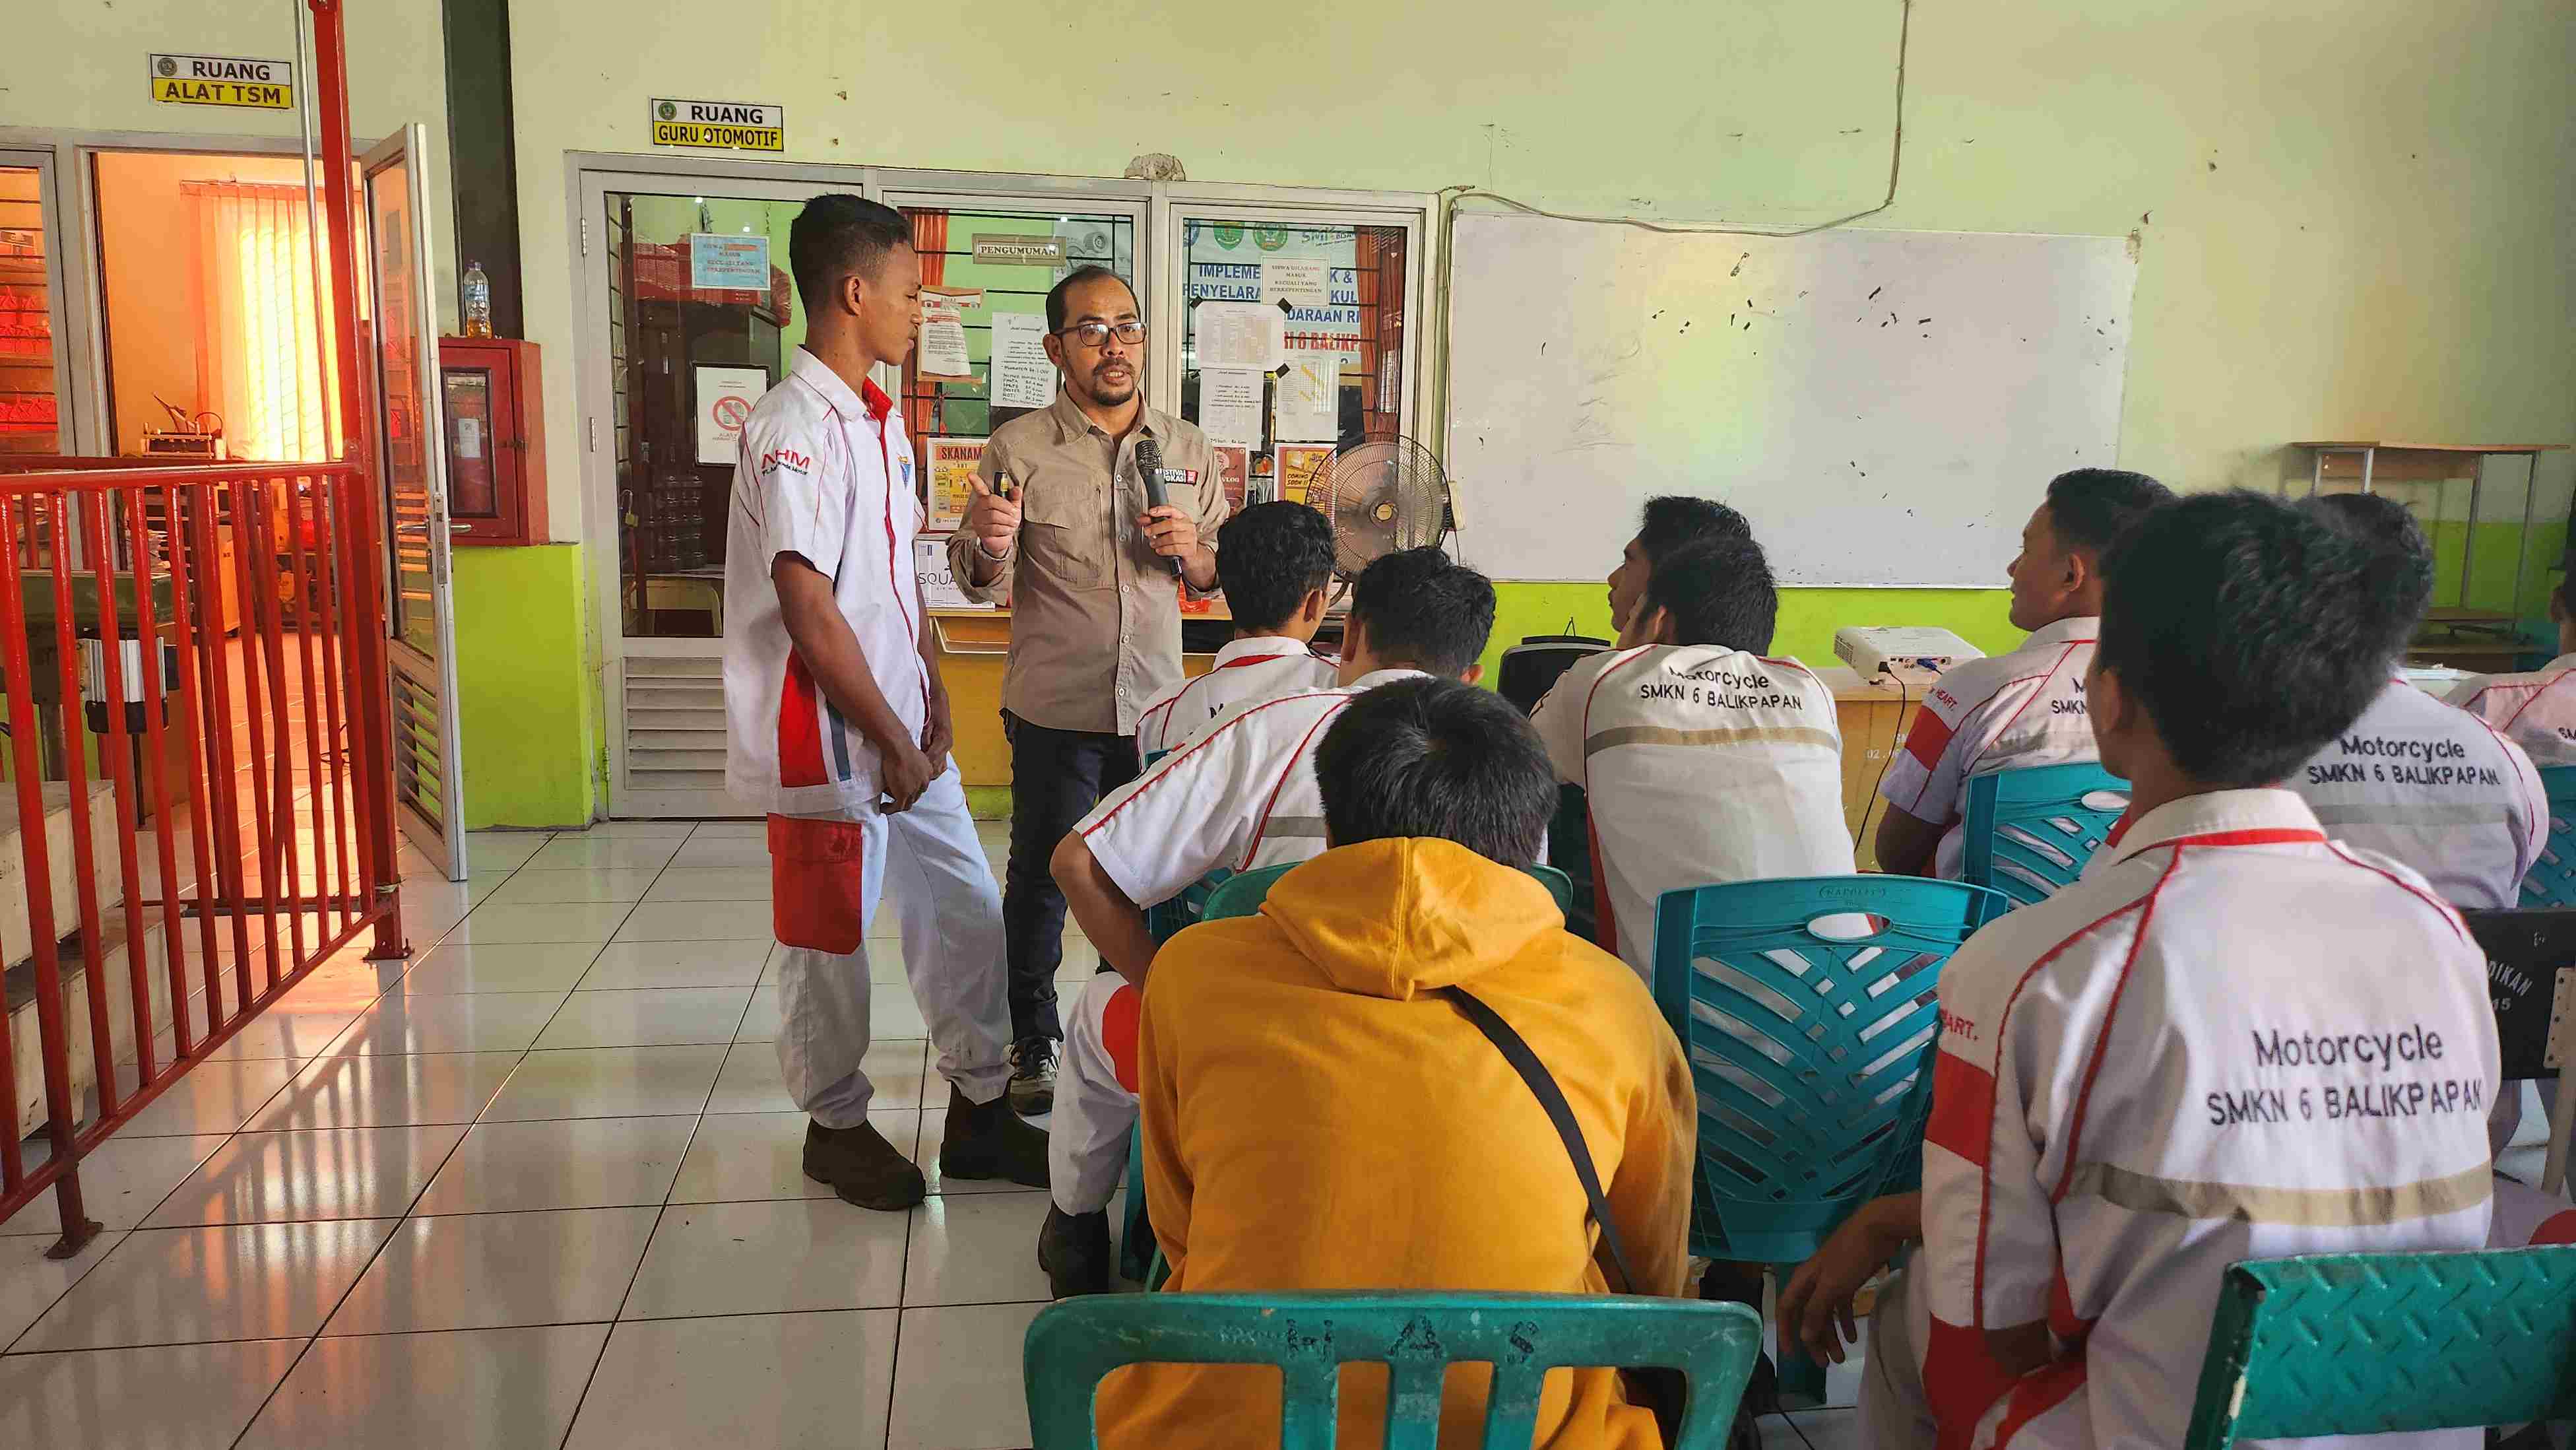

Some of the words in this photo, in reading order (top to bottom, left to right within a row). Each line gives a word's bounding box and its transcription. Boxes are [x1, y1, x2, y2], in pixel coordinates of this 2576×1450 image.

[193, 61, 271, 81] RUANG
[165, 82, 225, 100] ALAT
[232, 85, 280, 104] TSM
[691, 105, 763, 124] RUANG
[659, 125, 699, 143] GURU
[703, 127, 777, 146] OTOMOTIF
[981, 246, 1056, 256] PENGUMUMAN
[1343, 271, 1353, 284] &
[1640, 684, 1684, 700] SMKN
[1692, 687, 1700, 704] 6
[1707, 690, 1803, 710] BALIKPAPAN
[2339, 735, 2465, 763] Motorcycle
[2307, 763, 2366, 785] SMKN
[2373, 766, 2385, 783] 6
[2392, 766, 2501, 786] BALIKPAPAN
[2251, 1024, 2443, 1072] Motorcycle
[2206, 1088, 2289, 1126] SMKN
[2299, 1088, 2311, 1121] 6
